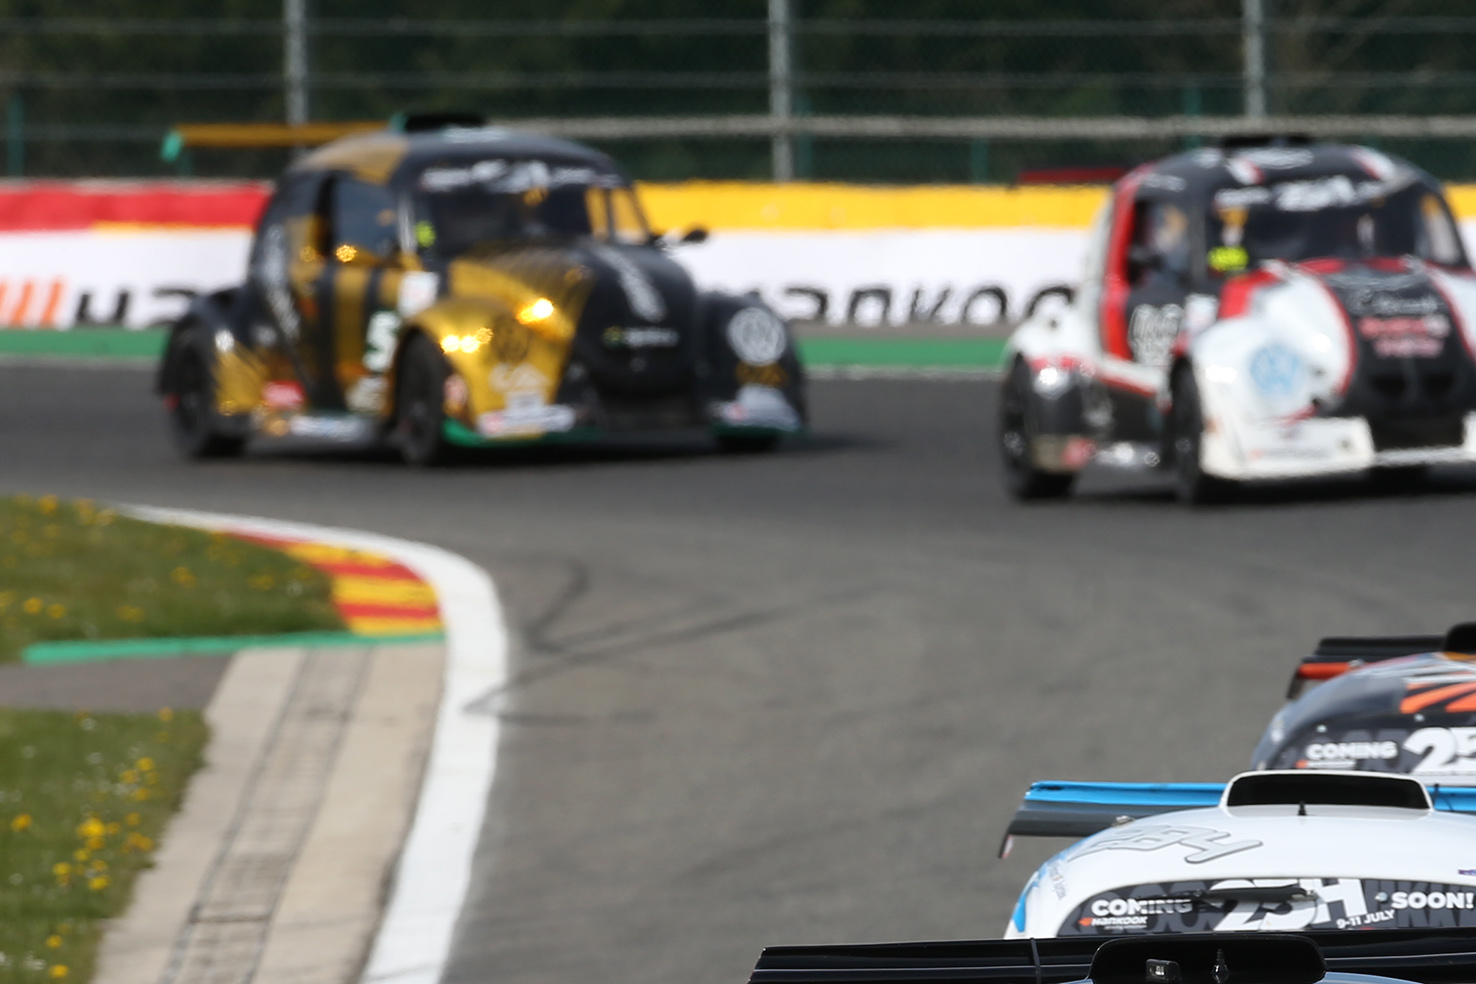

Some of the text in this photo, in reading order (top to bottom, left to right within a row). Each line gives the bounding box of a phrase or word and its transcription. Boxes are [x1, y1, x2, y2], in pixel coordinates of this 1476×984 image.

[1306, 741, 1398, 759] COMING
[1091, 898, 1193, 917] COMING
[1391, 891, 1474, 909] SOON!
[1364, 909, 1395, 924] JULY
